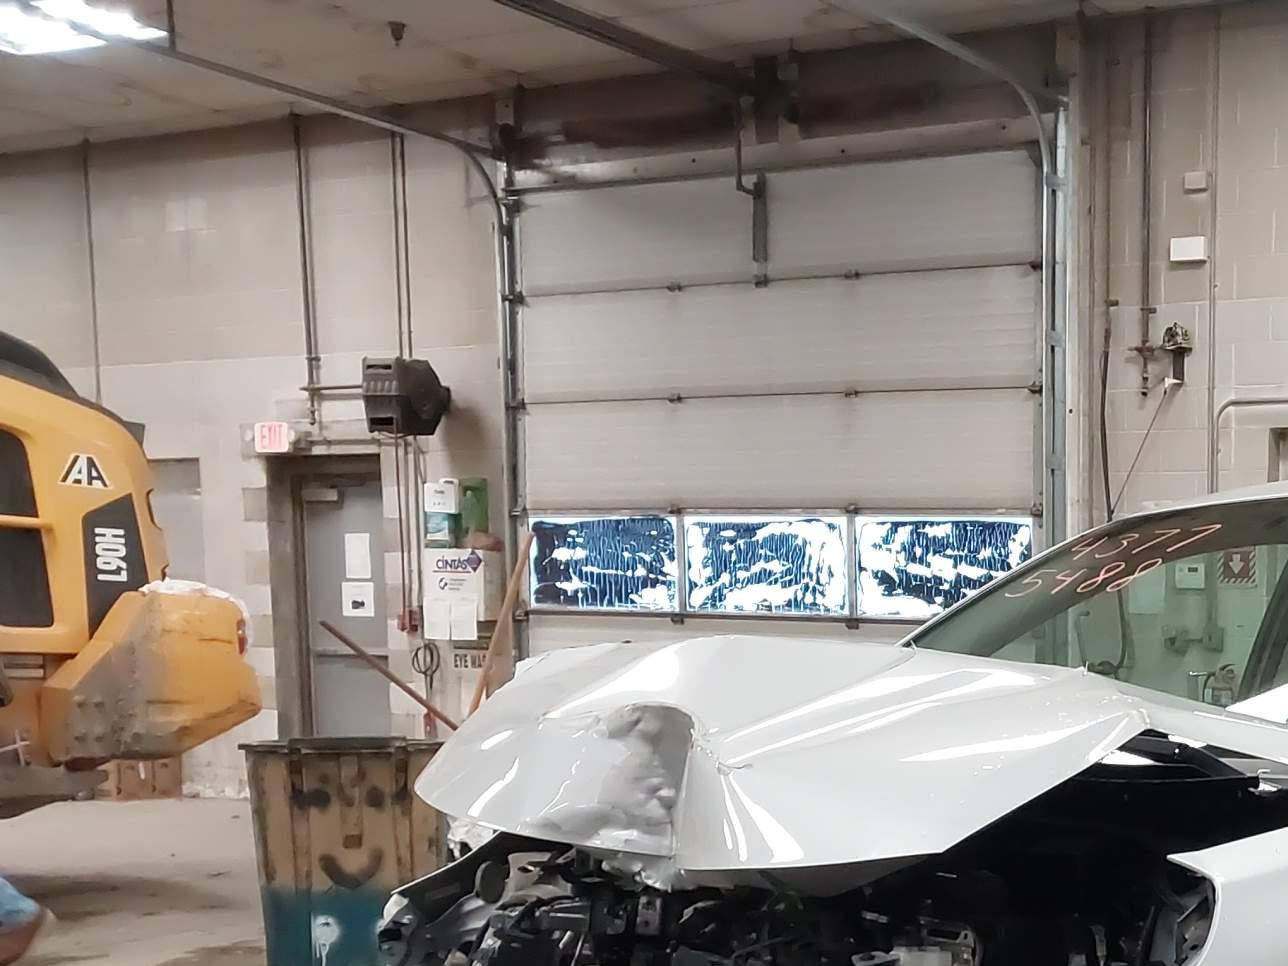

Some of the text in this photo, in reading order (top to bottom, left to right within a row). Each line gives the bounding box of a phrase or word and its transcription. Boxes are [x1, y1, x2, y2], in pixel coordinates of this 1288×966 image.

[260, 423, 284, 449] EXIT
[94, 527, 128, 582] L90H
[1071, 523, 1223, 560] 4377
[436, 555, 468, 570] CINTAS
[1004, 557, 1163, 598] 5488
[453, 653, 469, 669] EYE
